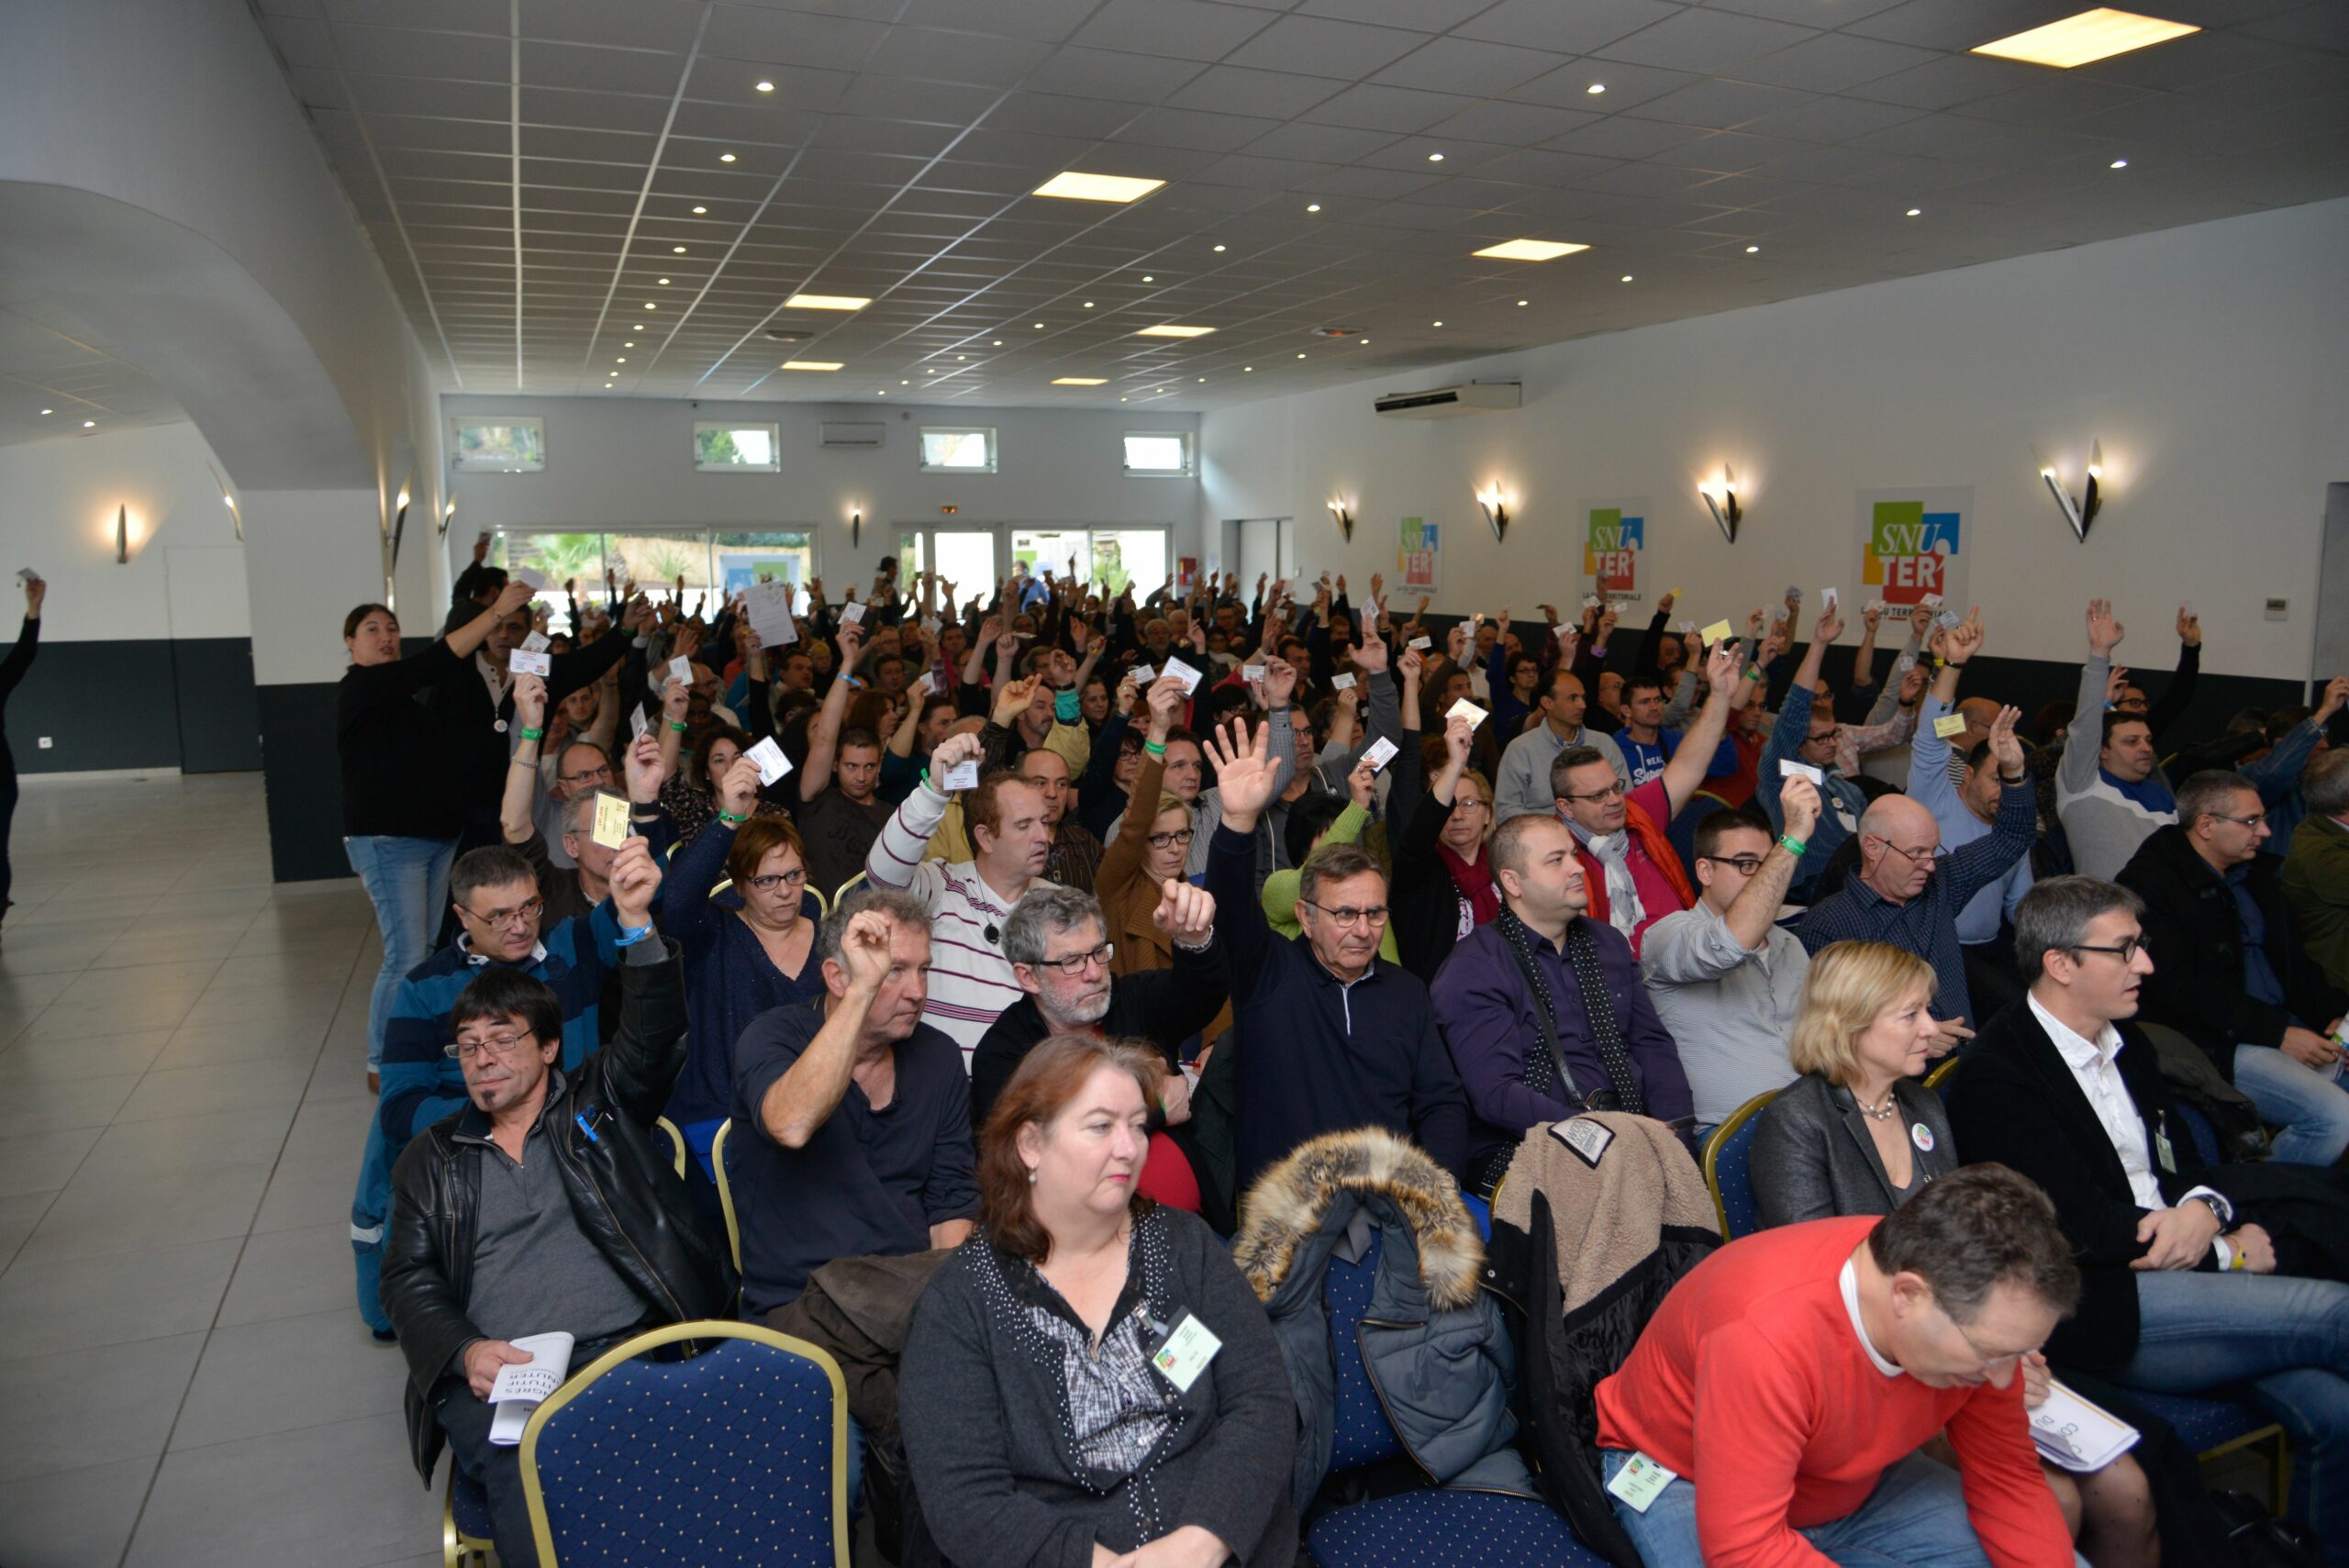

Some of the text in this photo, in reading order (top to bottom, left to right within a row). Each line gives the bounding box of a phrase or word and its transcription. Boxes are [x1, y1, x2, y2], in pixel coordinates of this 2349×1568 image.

[1594, 526, 1631, 550] SNU
[1878, 524, 1942, 554] SNU
[1878, 555, 1937, 588] TER
